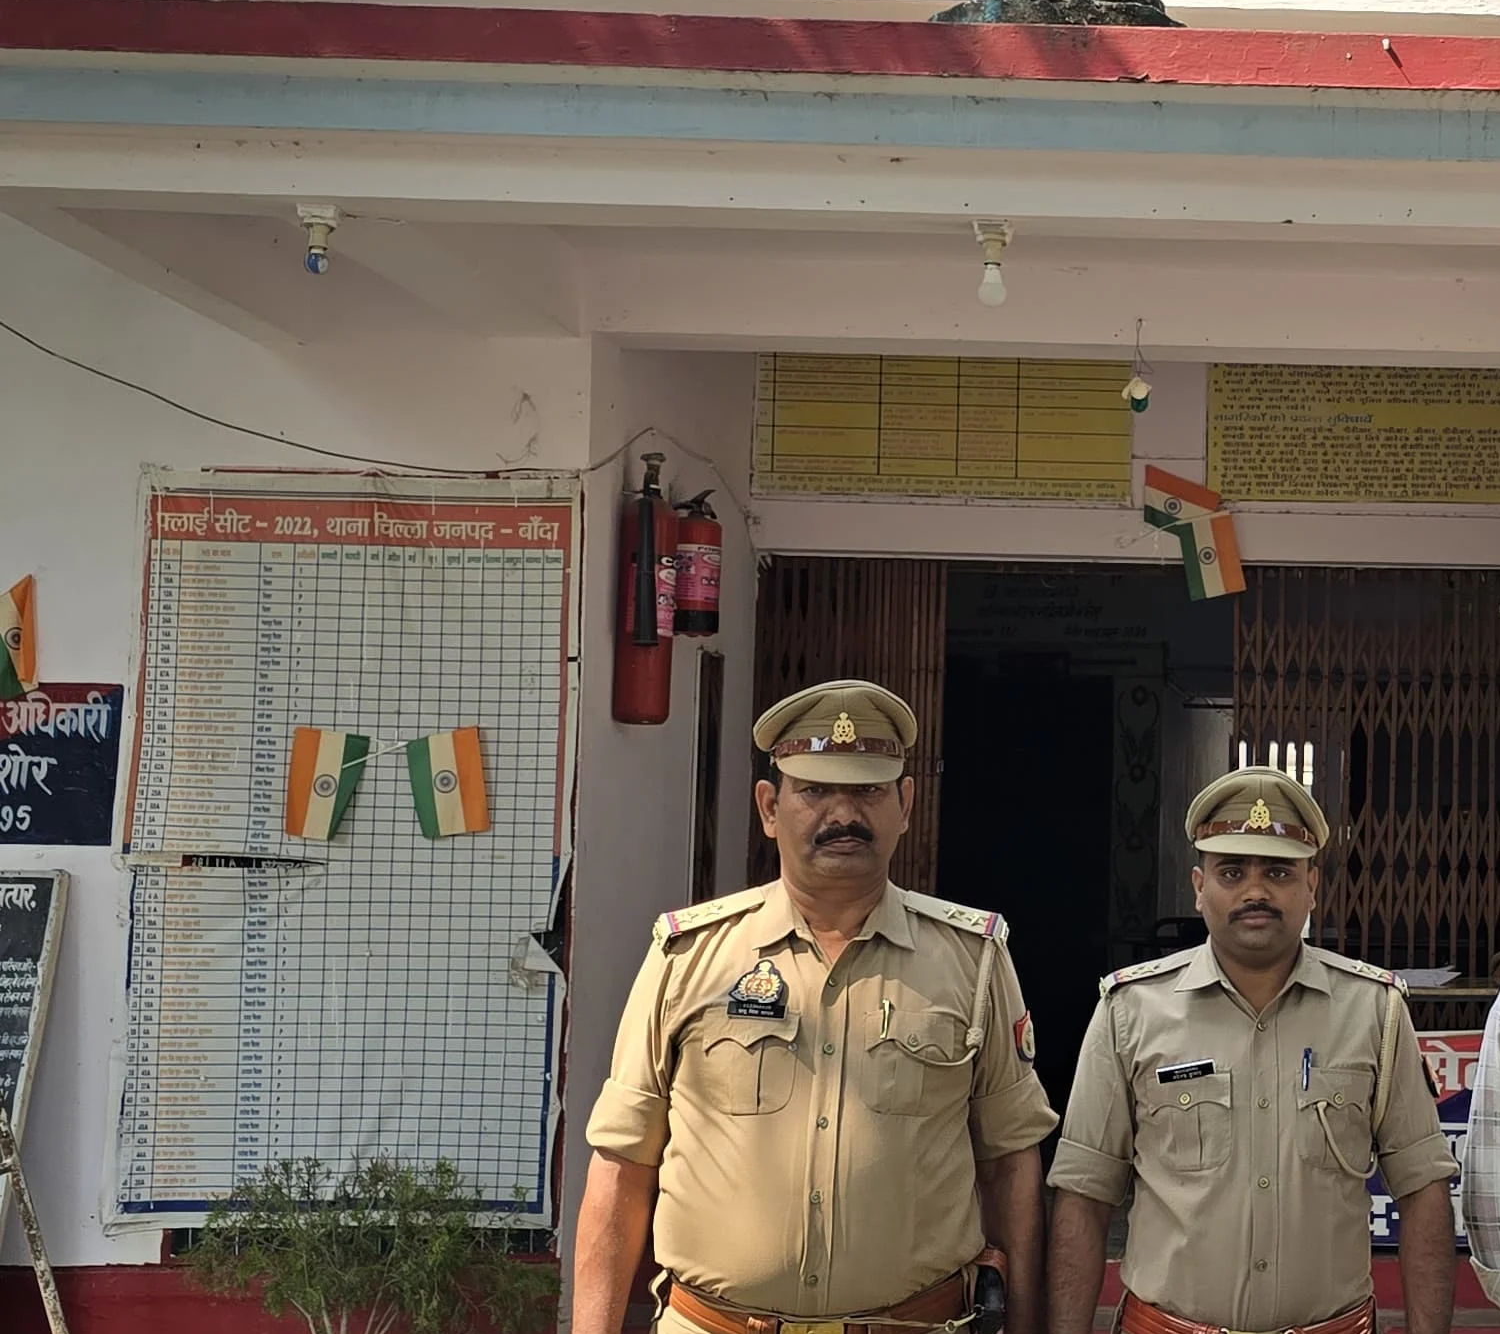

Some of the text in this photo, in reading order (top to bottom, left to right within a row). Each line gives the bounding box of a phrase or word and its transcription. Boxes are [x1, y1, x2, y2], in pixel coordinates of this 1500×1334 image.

[214, 512, 252, 534] सीट
[326, 517, 370, 537] थाना
[374, 509, 427, 539] चिल्ला
[433, 521, 495, 540] जनपद
[518, 515, 559, 541] बाँदा
[1, 691, 111, 742] अधिकारी
